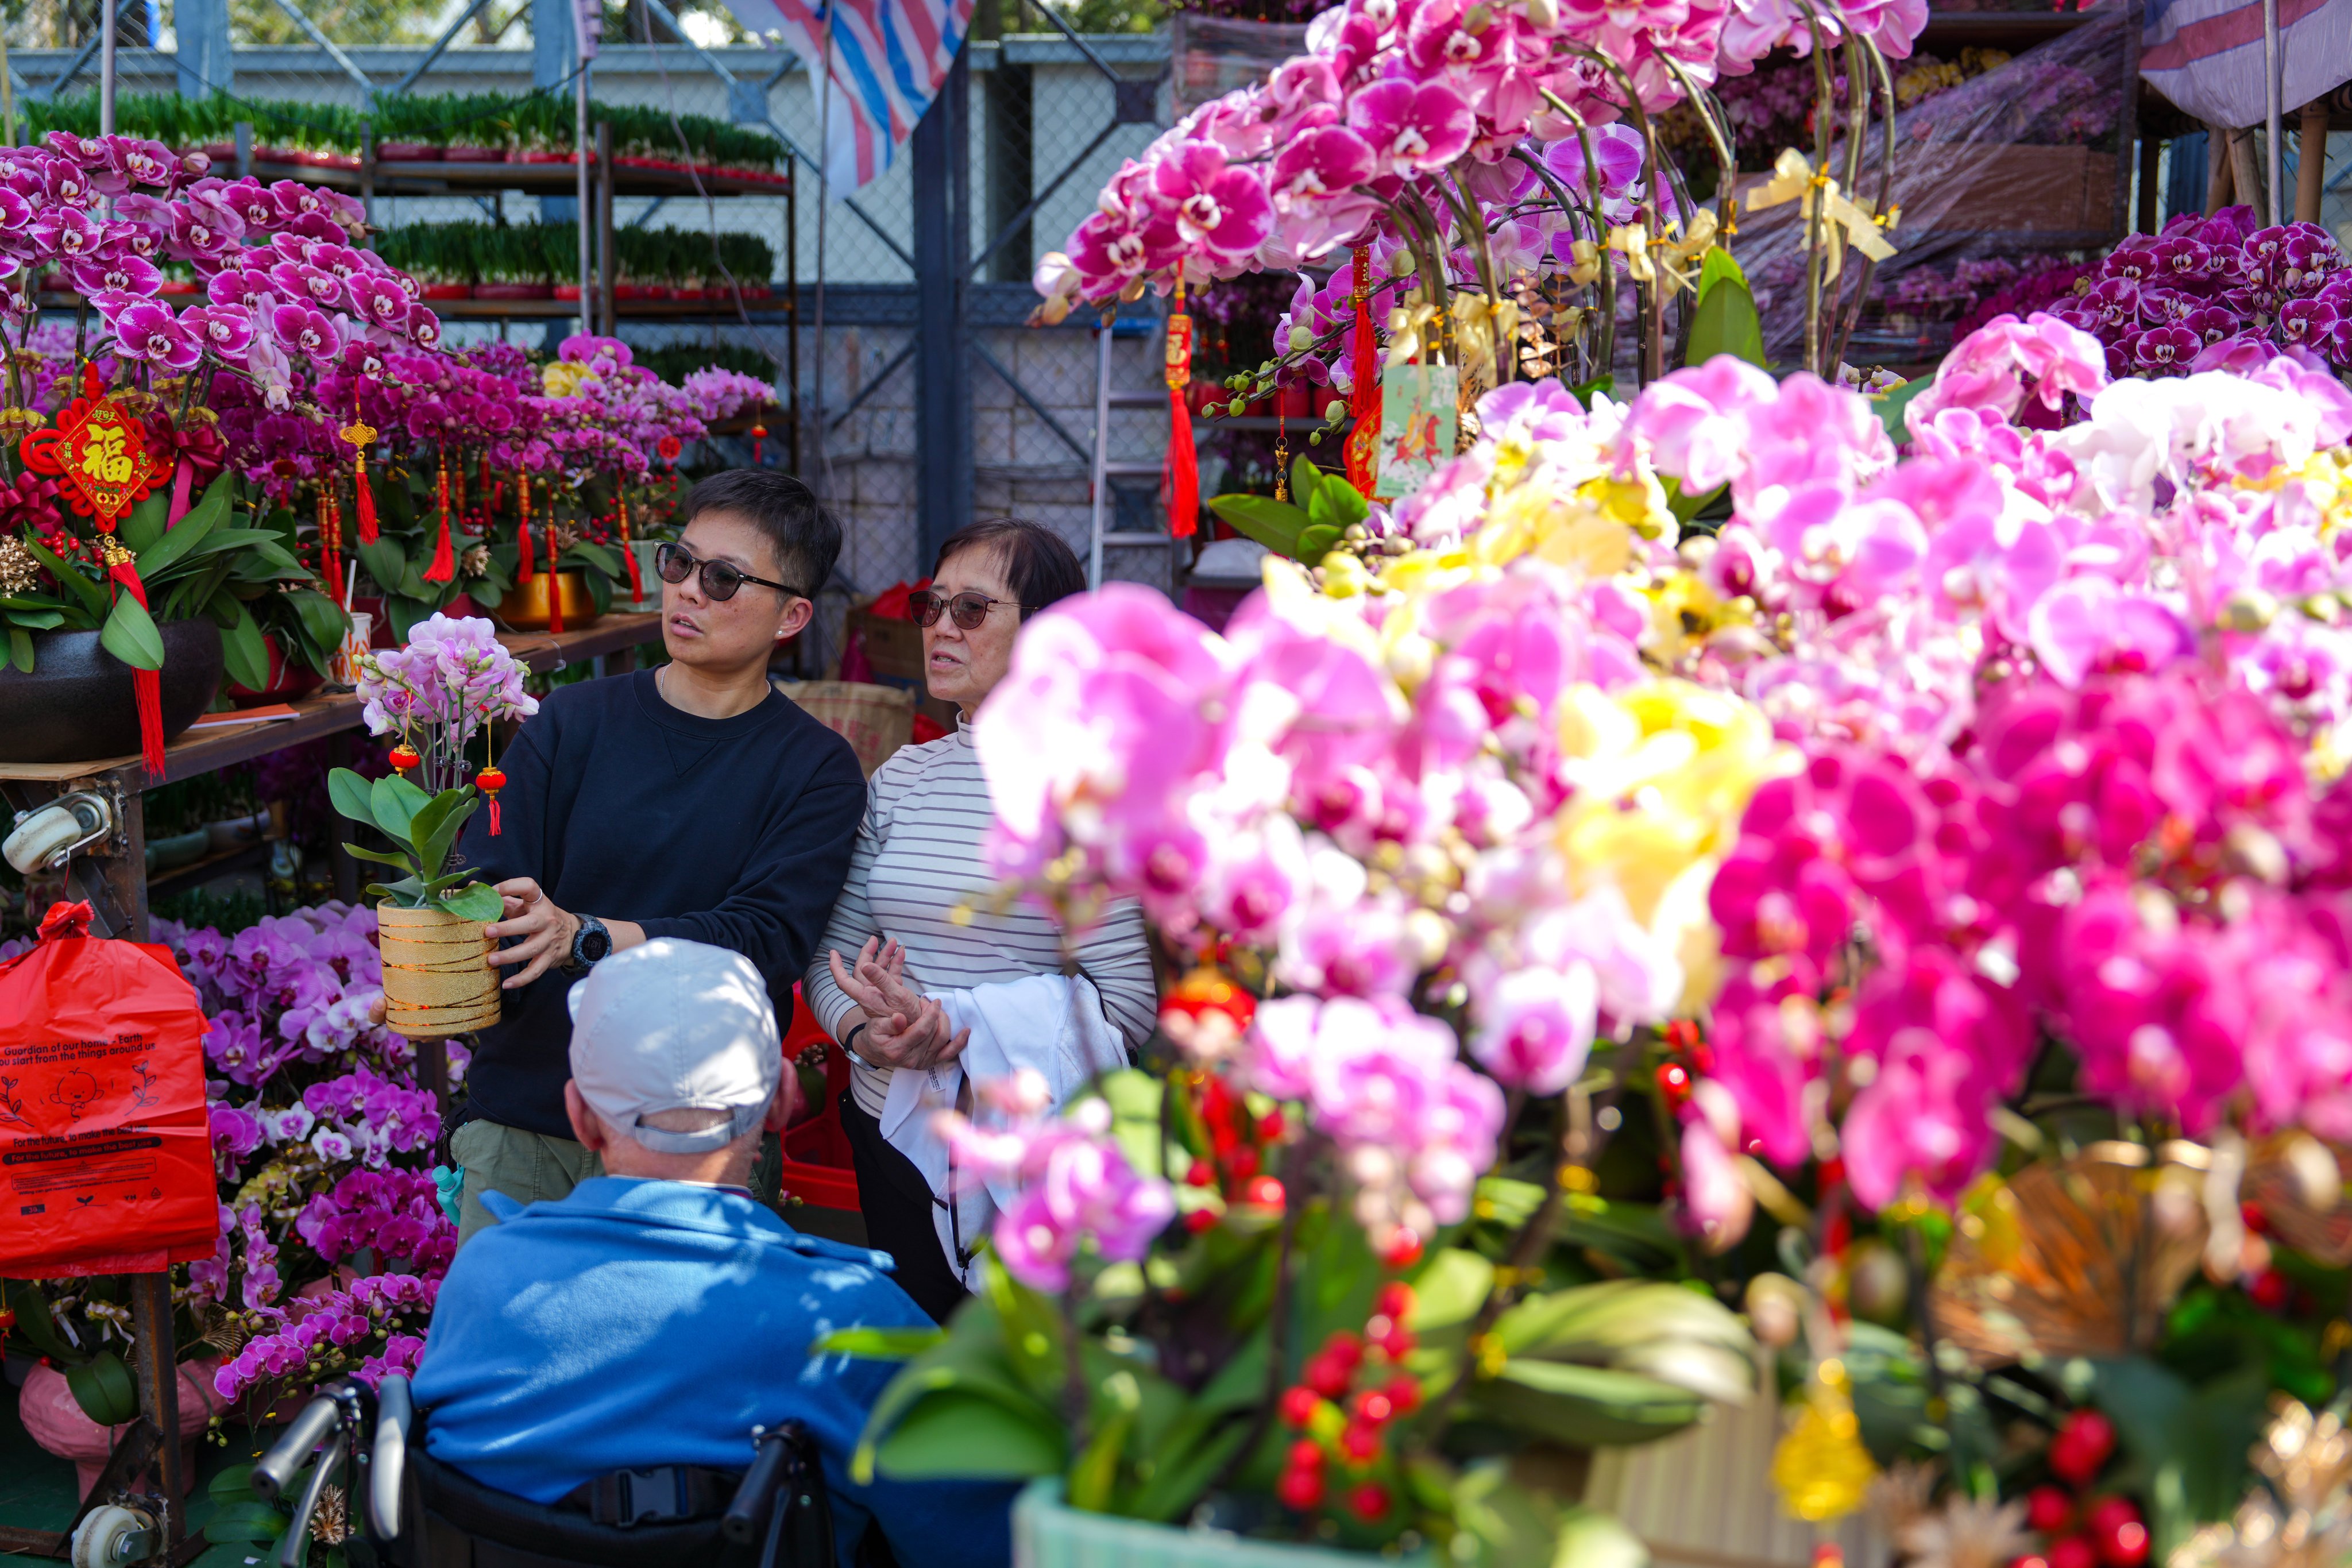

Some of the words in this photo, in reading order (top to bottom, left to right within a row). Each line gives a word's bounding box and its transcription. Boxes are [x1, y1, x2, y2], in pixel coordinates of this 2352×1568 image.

[92, 409, 118, 423] 好日子
[63, 441, 73, 459] 吉祥
[82, 423, 134, 484] 福
[137, 450, 148, 466] 如意
[5, 1045, 48, 1056] Guardian
[51, 1042, 60, 1052] of
[81, 1040, 108, 1048] home
[119, 1033, 142, 1044] Earth
[13, 1056, 33, 1065] start
[36, 1055, 58, 1063] from
[60, 1052, 76, 1061] the
[79, 1049, 107, 1059] things
[110, 1042, 142, 1055] around
[14, 1138, 26, 1148] For
[27, 1137, 41, 1146] the
[41, 1136, 67, 1145] future,
[69, 1134, 77, 1142] to
[79, 1130, 101, 1140] make
[102, 1127, 115, 1137] the
[117, 1125, 133, 1135] best
[134, 1125, 148, 1133] use
[11, 1154, 25, 1162] For
[41, 1150, 68, 1159] future,
[79, 1146, 102, 1154] make
[103, 1144, 117, 1152] the
